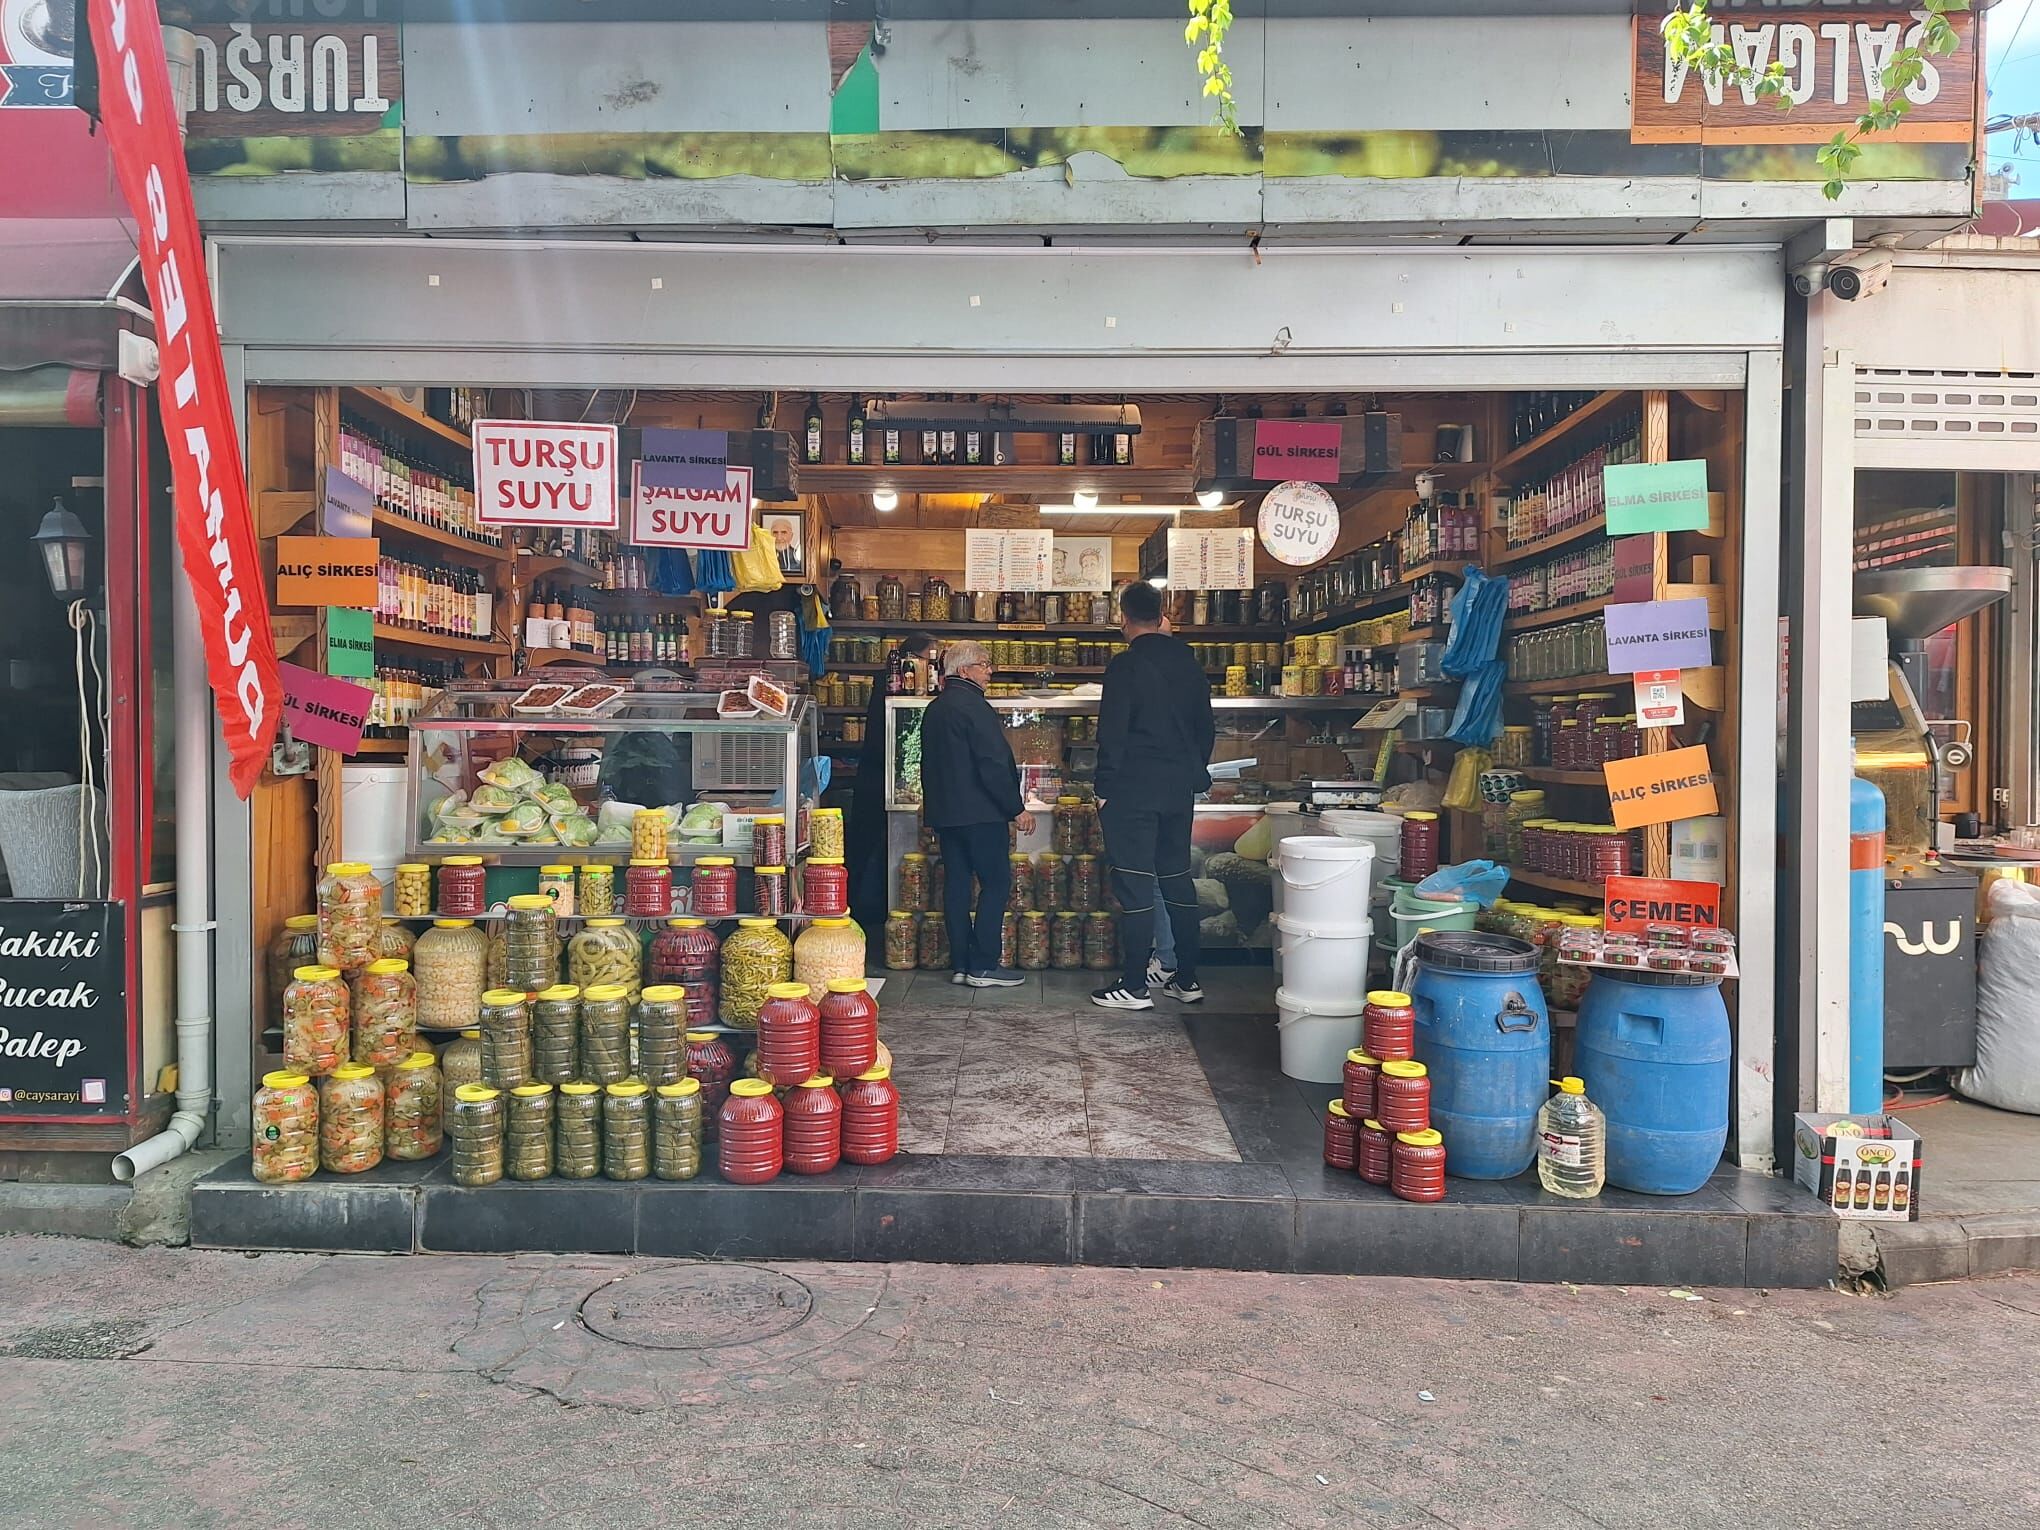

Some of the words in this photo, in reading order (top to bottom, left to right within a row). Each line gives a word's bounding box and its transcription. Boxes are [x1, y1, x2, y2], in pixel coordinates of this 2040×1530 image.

[485, 438, 604, 477] TURŞU
[643, 455, 686, 464] LAVANTA
[689, 455, 727, 465] SİRKESİ
[1257, 445, 1283, 457] GÜL
[1287, 445, 1338, 458] SİRKESİ
[498, 480, 592, 511] SUYU
[1608, 494, 1646, 507] ELMA
[1649, 486, 1705, 503] SİRKESİ
[652, 509, 731, 536] SUYU
[1273, 502, 1328, 528] TURŞU
[1273, 523, 1319, 545] SUYU
[277, 564, 313, 579] ALIÇ
[317, 562, 378, 577] SİRKESİ
[329, 637, 348, 649] ELMA
[349, 637, 373, 652] SİRKESİ
[1608, 633, 1660, 646] LAVANTA
[1662, 627, 1708, 641] SİRKESİ
[283, 692, 300, 710] ÜL
[304, 702, 364, 729] SİRKESİ
[1611, 786, 1647, 803] ALIÇ
[1650, 769, 1714, 795] SİRKESİ
[1608, 899, 1714, 924] ÇEMEN
[0, 926, 100, 958] akiki
[14, 1089, 80, 1103] @caysarayi
